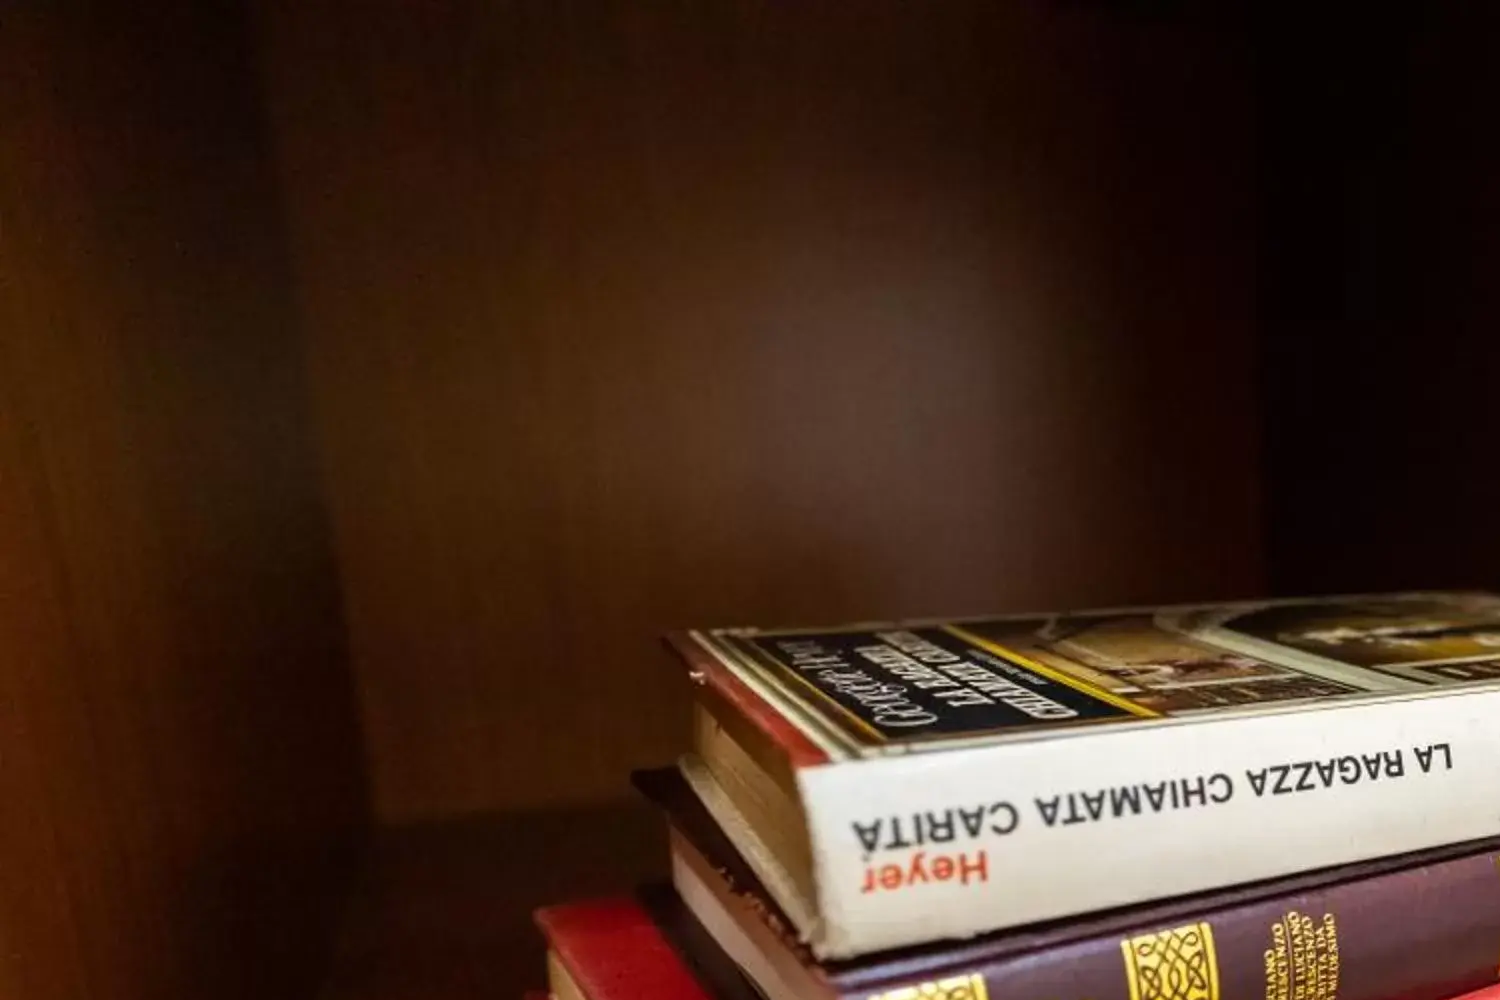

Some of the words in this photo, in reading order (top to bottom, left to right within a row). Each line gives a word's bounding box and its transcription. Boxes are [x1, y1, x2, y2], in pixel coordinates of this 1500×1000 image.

[933, 687, 996, 707] LA
[1246, 749, 1405, 797] RAGAZZA
[1413, 742, 1453, 773] LA
[1034, 773, 1233, 827] CHIAMATA
[860, 850, 988, 893] Heyer
[1288, 911, 1305, 982] LUCIANO
[1315, 926, 1327, 949] DA
[1323, 913, 1340, 993] MEDESIMO
[1293, 985, 1305, 1000] DI
